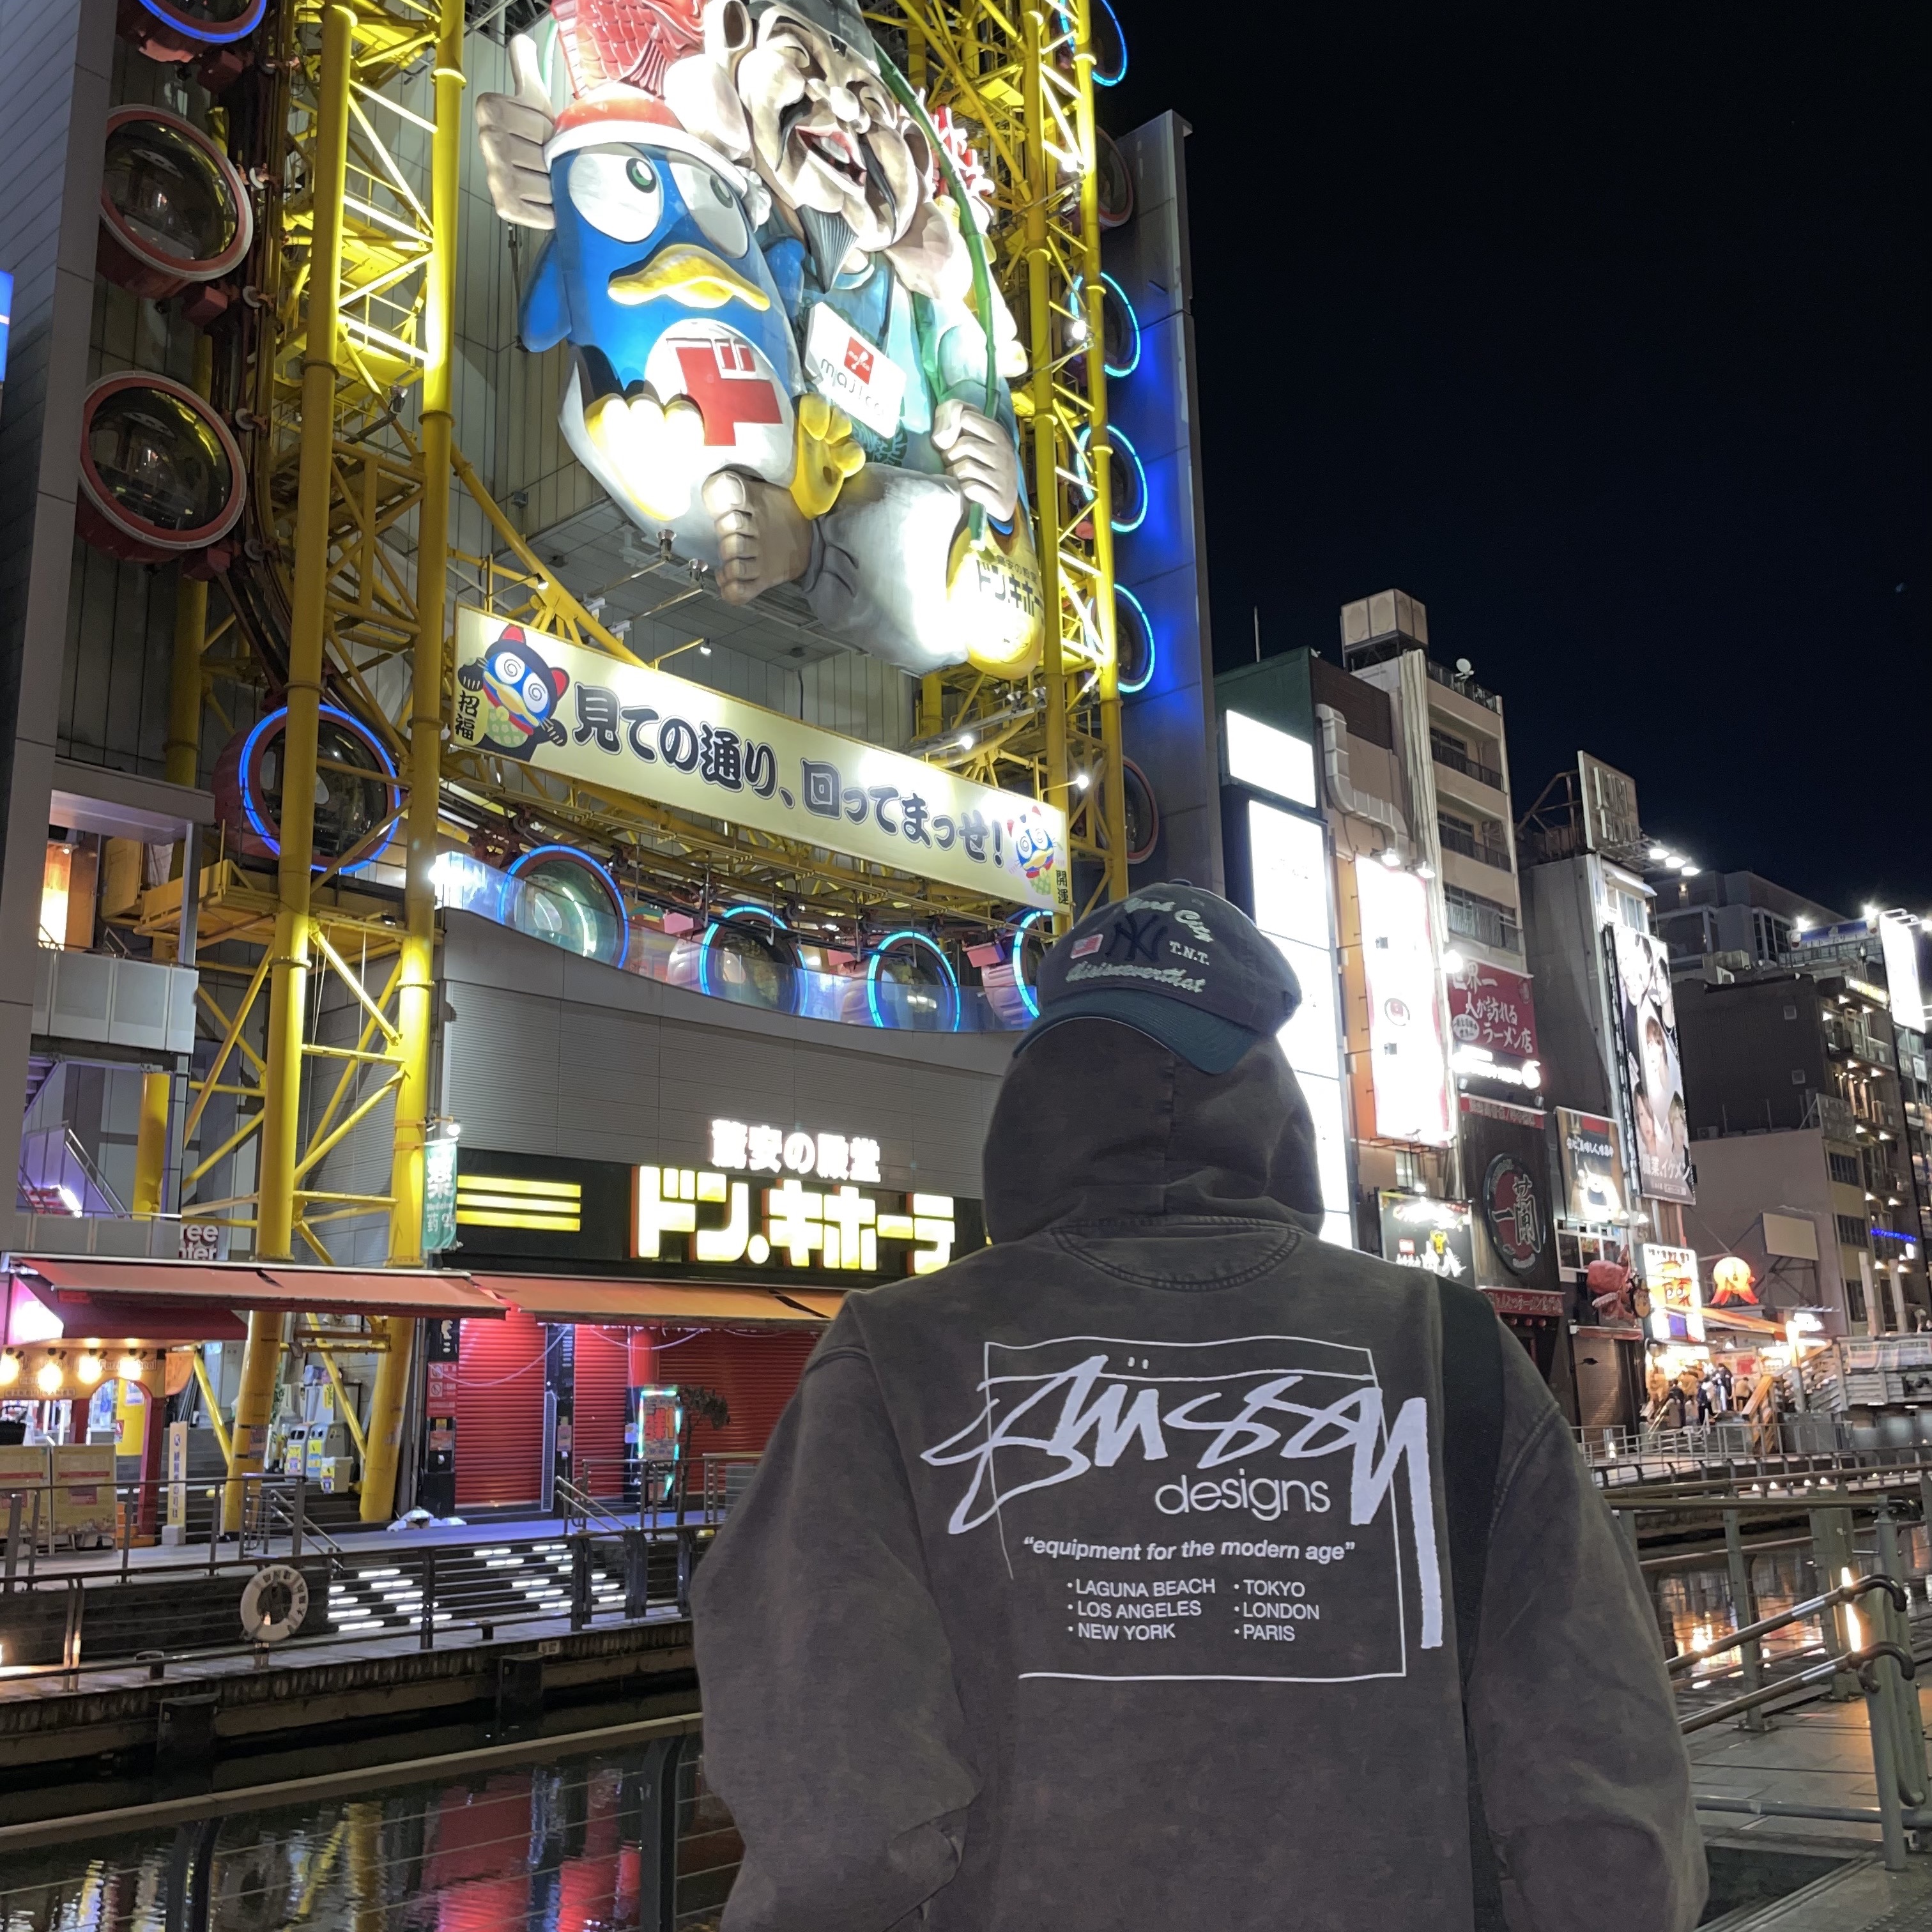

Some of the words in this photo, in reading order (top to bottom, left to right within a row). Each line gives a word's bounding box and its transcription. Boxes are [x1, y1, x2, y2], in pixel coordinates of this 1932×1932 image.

[456, 690, 480, 741] 招福
[1056, 870, 1069, 905] 開運
[1169, 940, 1210, 966] T.N.T.
[1482, 1022, 1533, 1054] ラーメン店
[1491, 1174, 1541, 1253] 一蘭
[1154, 1468, 1331, 1521] designs
[1146, 1542, 1177, 1561] for
[1181, 1540, 1215, 1557] the
[1220, 1539, 1300, 1560] modern
[1075, 1578, 1149, 1597] LAGUNA
[1153, 1578, 1216, 1597] BEACH
[1243, 1579, 1306, 1597] TOKYO
[1077, 1600, 1112, 1618] LOS
[1116, 1600, 1202, 1620] ANGELES
[1243, 1602, 1320, 1620] LONDON
[1078, 1622, 1119, 1640] NEW
[1123, 1623, 1176, 1641] YORK
[1243, 1623, 1296, 1641] PARIS
